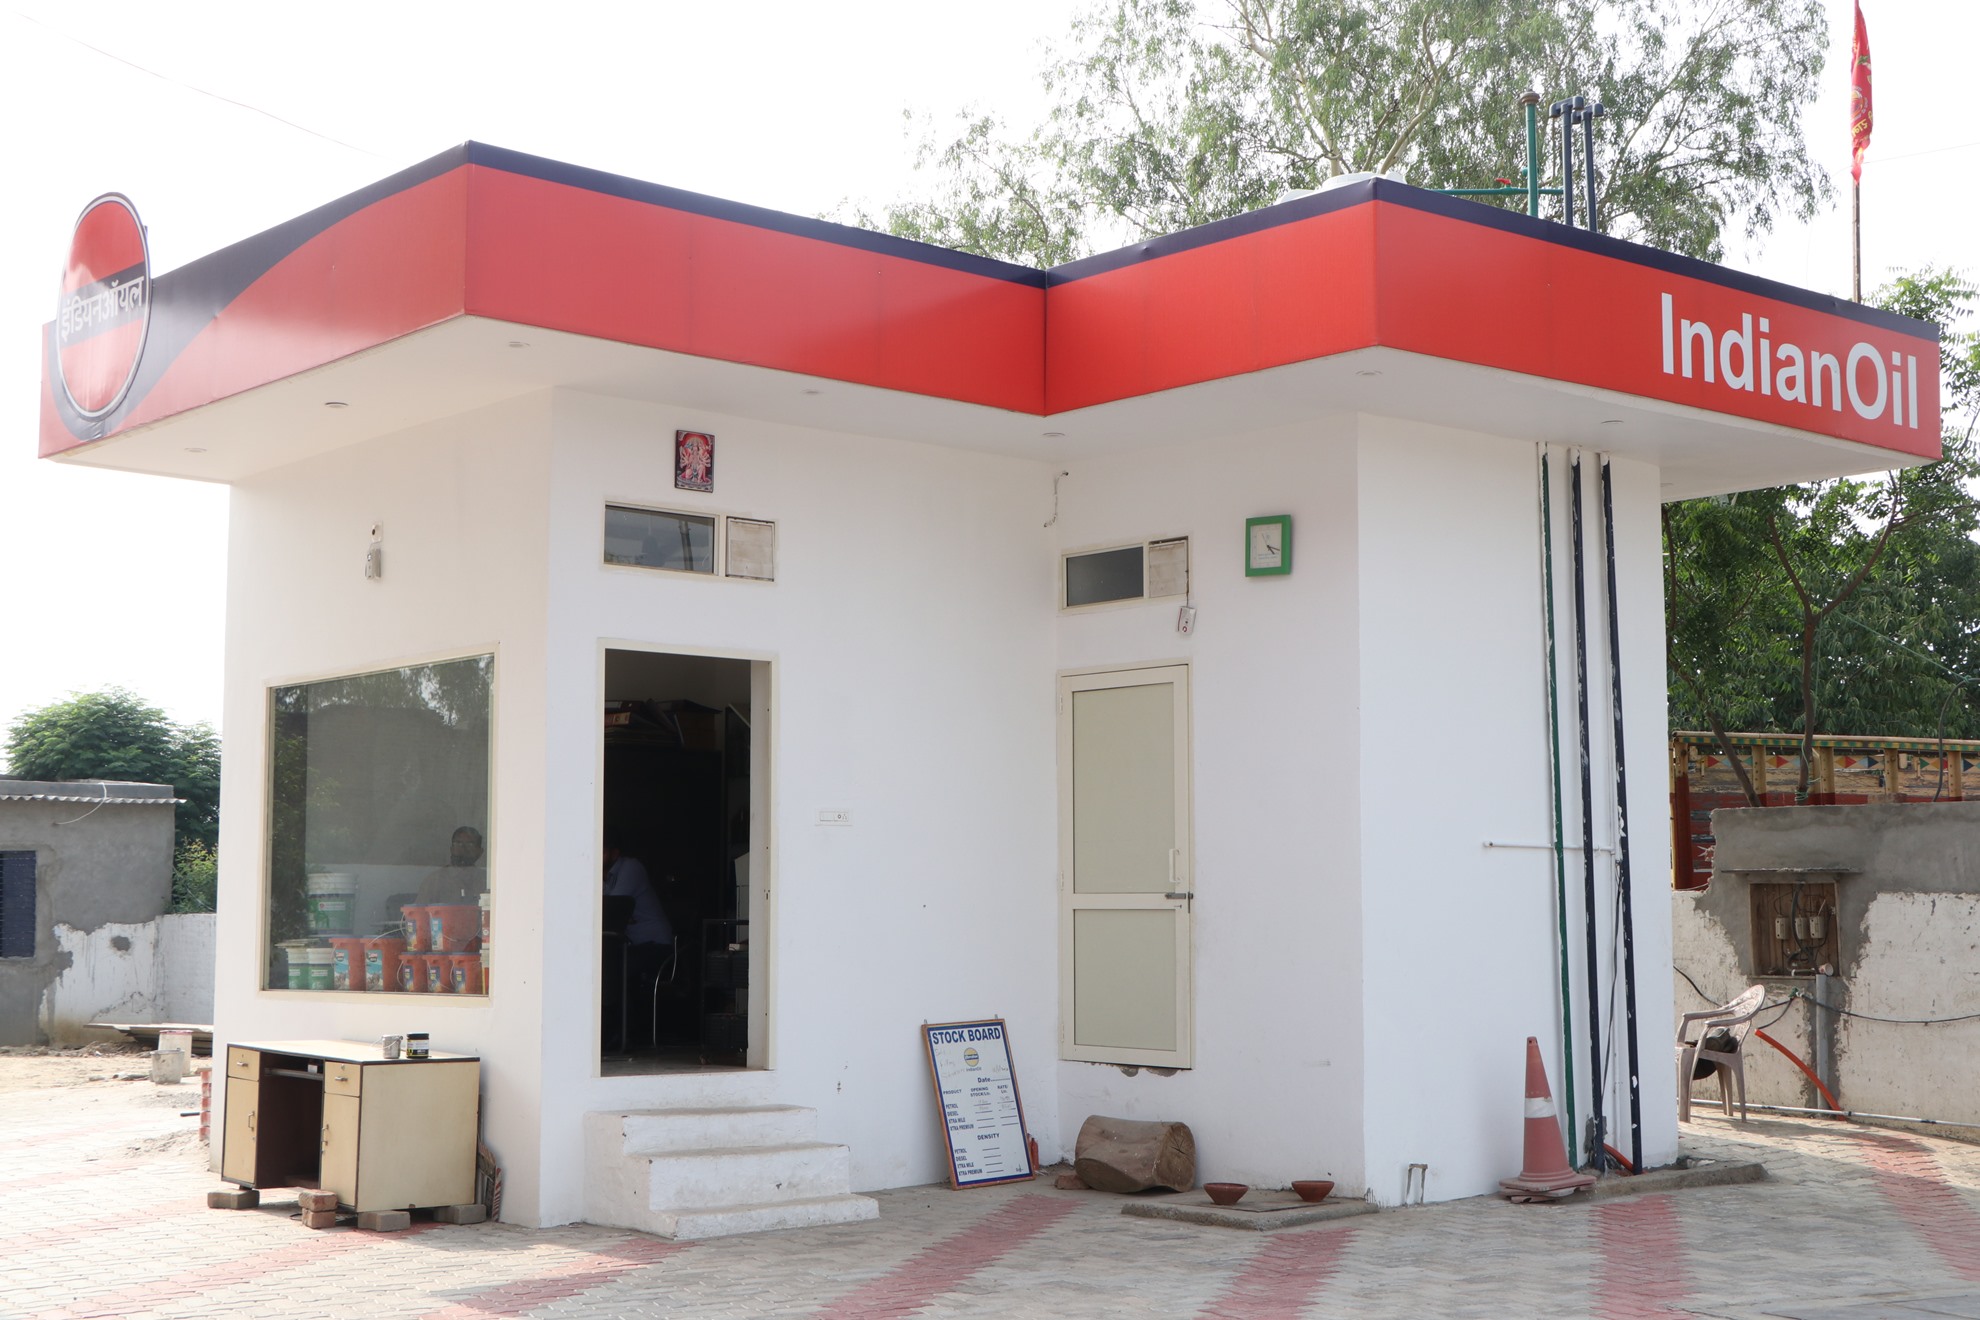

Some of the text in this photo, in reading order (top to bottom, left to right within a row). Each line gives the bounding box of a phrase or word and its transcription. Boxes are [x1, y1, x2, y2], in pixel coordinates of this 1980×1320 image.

[60, 276, 145, 343] इंडियनऑयल
[1661, 292, 1918, 429] IndianOil
[932, 1027, 1001, 1045] STOCK BOARD
